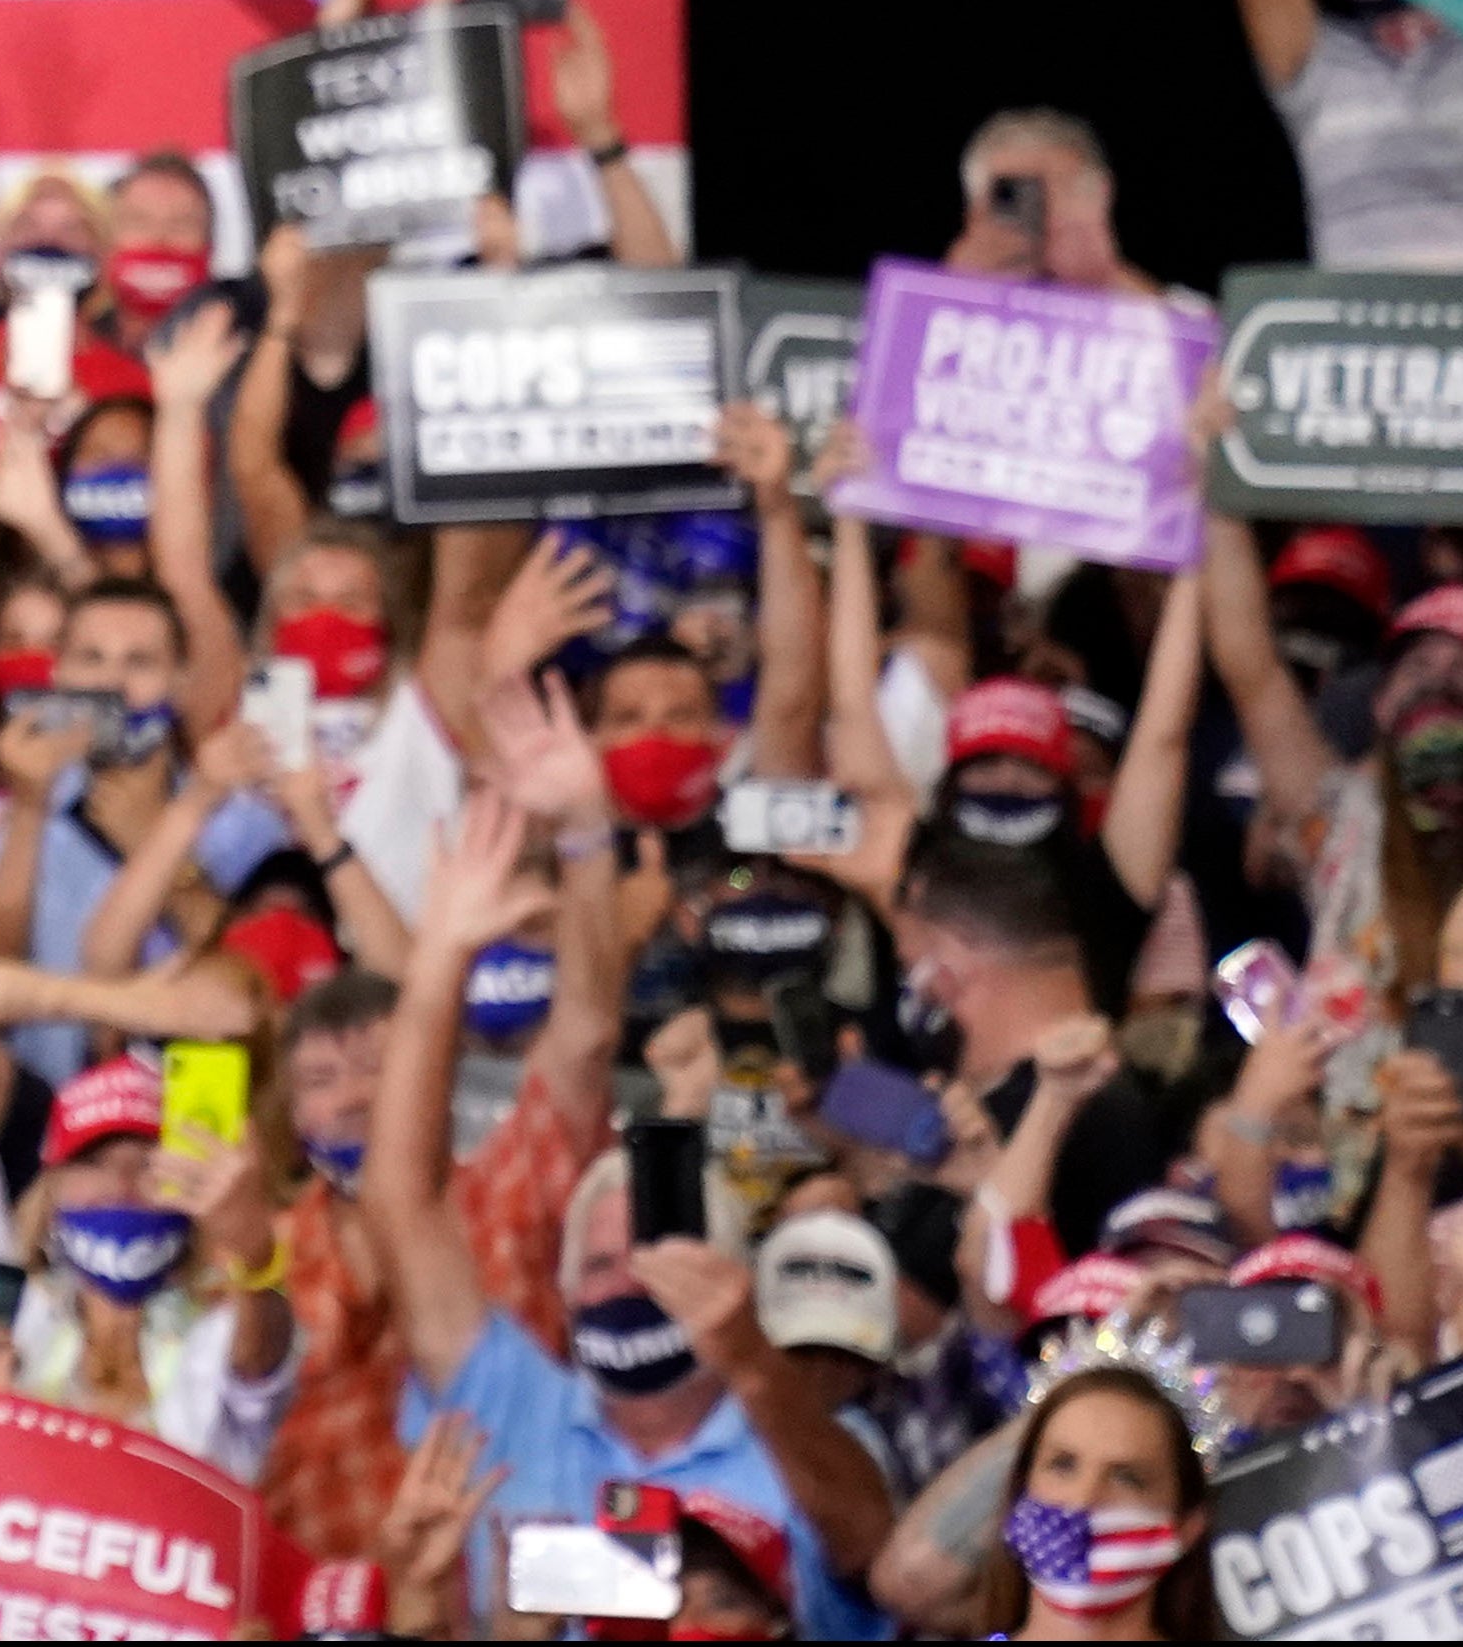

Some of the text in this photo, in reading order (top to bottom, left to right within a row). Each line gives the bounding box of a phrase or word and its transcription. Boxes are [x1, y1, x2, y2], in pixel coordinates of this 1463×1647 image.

[413, 330, 581, 412] COPS
[919, 308, 1173, 406] PRO-LIFE
[916, 380, 1089, 450] VOICES
[1211, 1473, 1439, 1637] COPS
